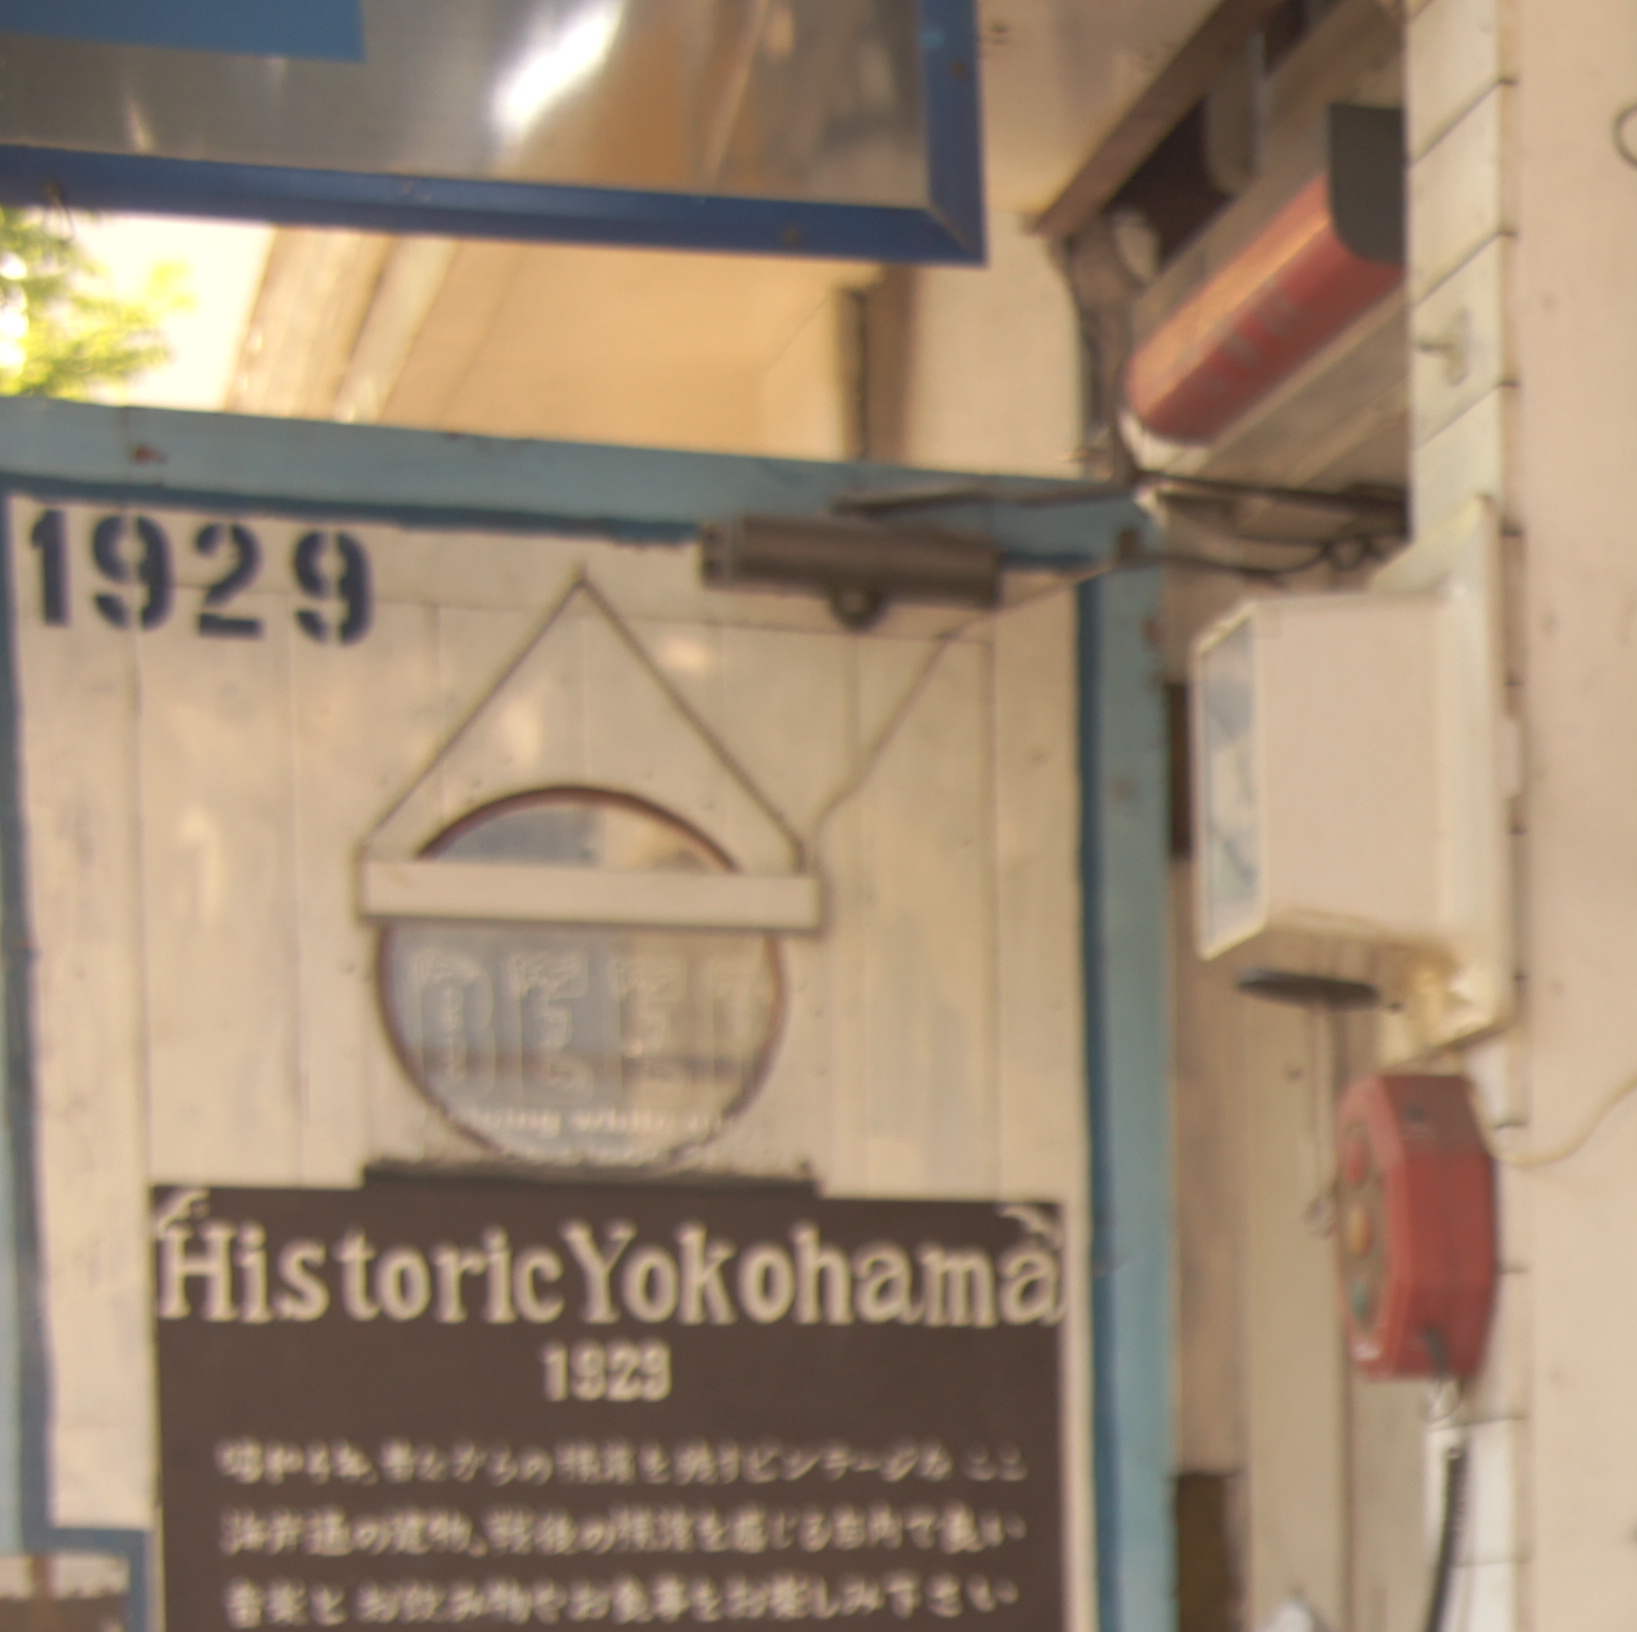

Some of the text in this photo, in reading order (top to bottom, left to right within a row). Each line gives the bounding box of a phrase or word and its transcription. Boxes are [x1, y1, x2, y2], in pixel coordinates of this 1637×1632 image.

[29, 506, 374, 645] 1929
[157, 1221, 1065, 1327] Historic Yokohama
